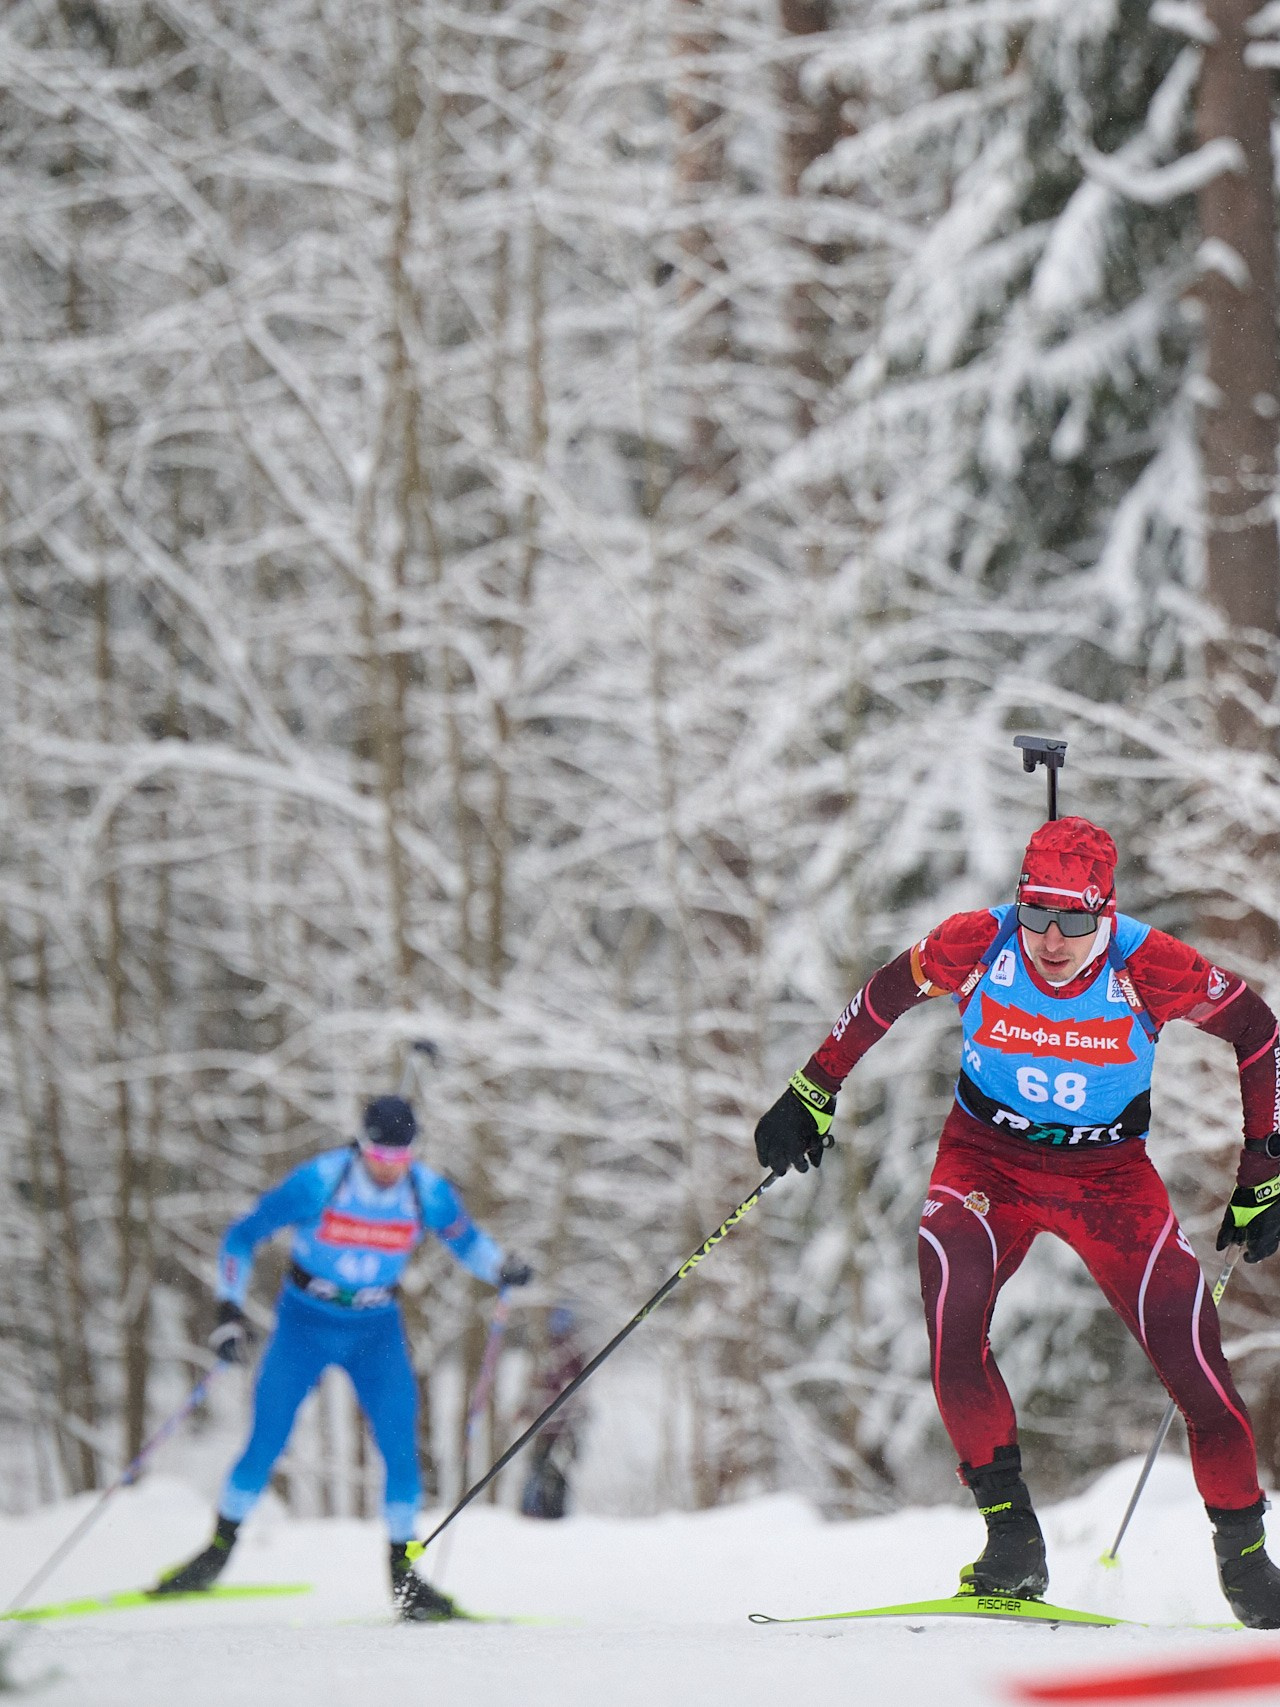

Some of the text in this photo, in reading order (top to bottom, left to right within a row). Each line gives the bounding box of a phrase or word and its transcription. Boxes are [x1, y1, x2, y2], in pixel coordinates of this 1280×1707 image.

[990, 1019, 1119, 1050] Альфа Банк
[1016, 1066, 1088, 1112] 68
[977, 1598, 1021, 1612] FISCHER
